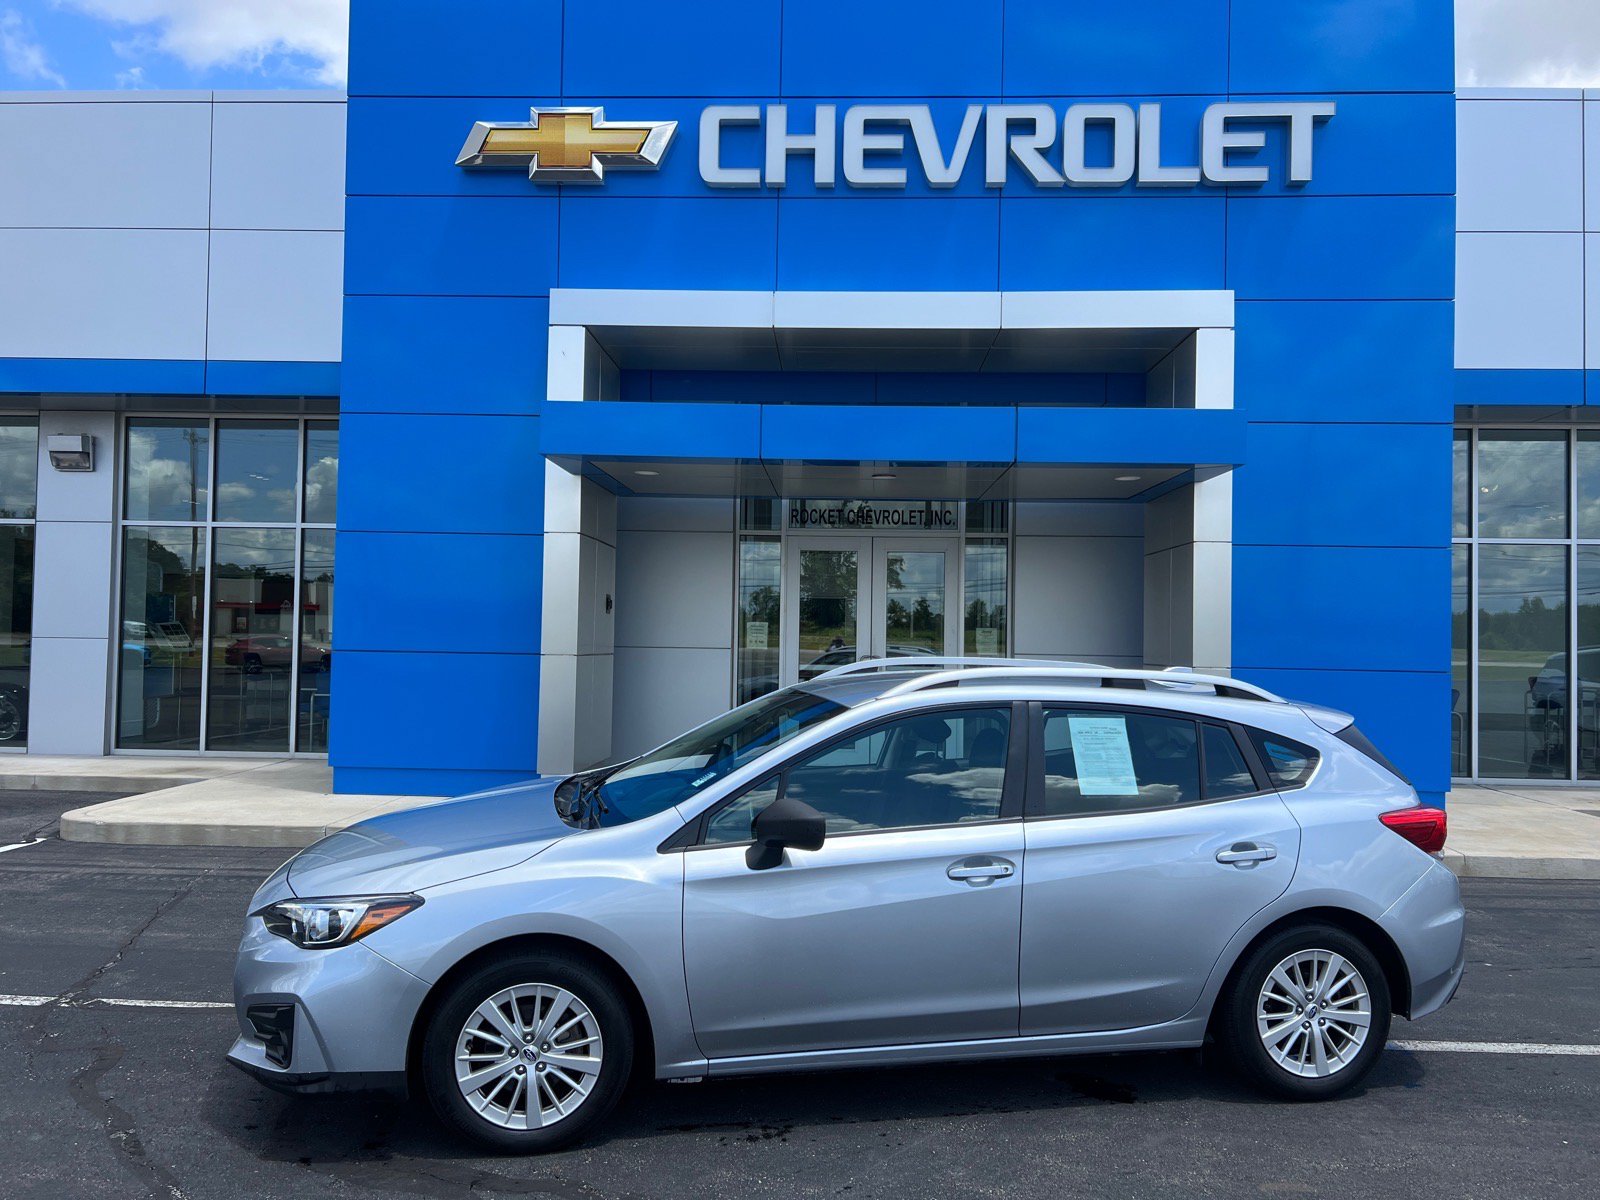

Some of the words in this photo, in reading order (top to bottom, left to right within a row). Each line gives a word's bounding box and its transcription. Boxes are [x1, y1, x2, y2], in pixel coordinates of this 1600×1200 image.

[699, 102, 1336, 187] CHEVROLET
[791, 508, 843, 524] ROCKET
[931, 510, 956, 526] INC.
